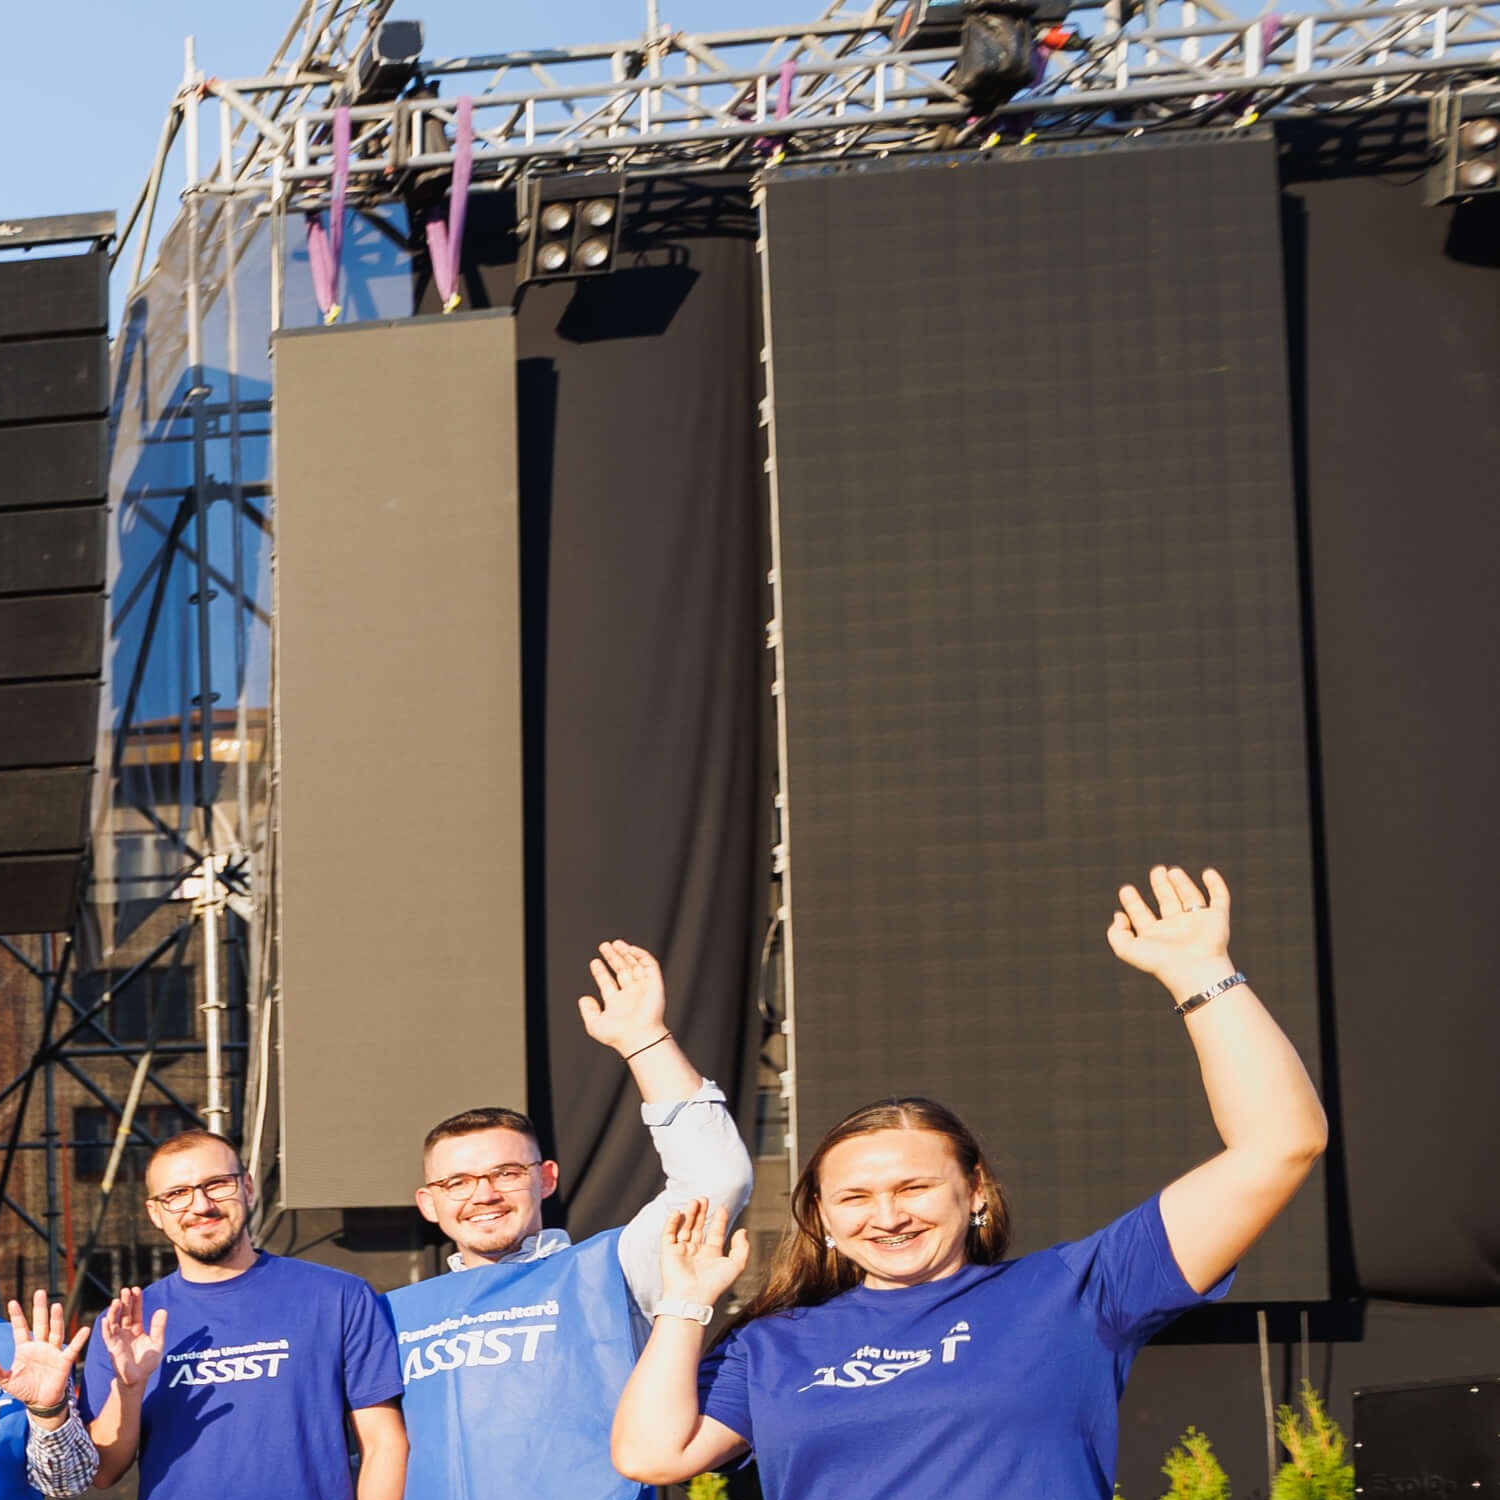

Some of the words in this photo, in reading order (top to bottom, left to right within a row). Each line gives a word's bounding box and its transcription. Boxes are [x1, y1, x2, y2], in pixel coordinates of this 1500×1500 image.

[166, 1348, 220, 1363] Fundația
[168, 1353, 289, 1388] ASSIST
[403, 1324, 557, 1386] ASSIST
